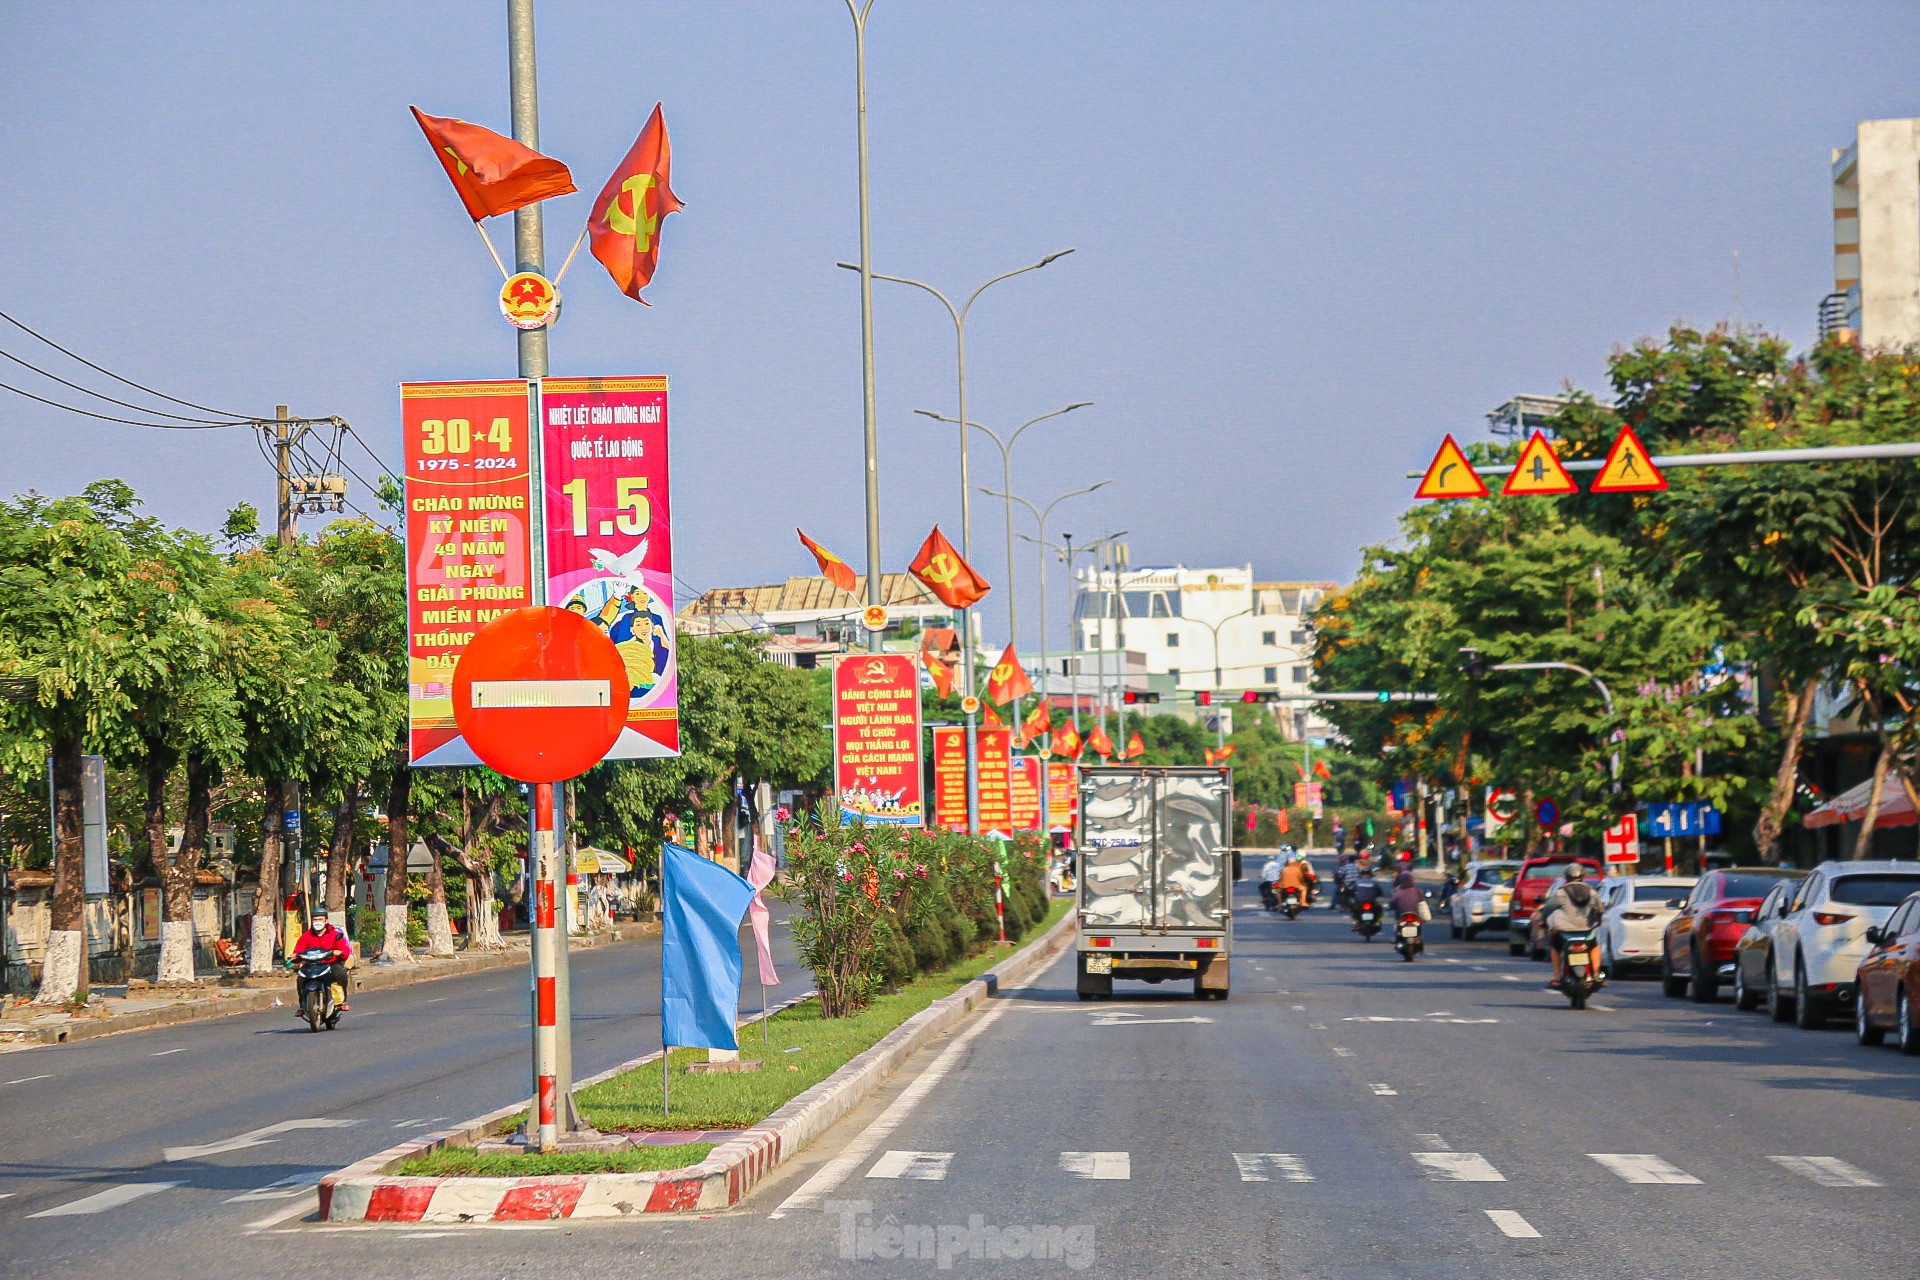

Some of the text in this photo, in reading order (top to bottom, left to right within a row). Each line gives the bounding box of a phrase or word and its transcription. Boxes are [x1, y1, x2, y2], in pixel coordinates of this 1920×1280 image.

[549, 402, 661, 429] NHIỆT LIỆT CHÀO MỪNG NGÀY
[421, 417, 512, 454] 30 4
[571, 435, 644, 461] QUỐC TẾ LAO ĐỘNG
[417, 459, 459, 471] 1975
[474, 458, 517, 470] 2024
[412, 494, 525, 512] CHÀO MỪNG
[562, 477, 652, 537] 1.5
[429, 516, 508, 535] KỶ NIỆM
[433, 539, 506, 556] 49 NĂM
[445, 561, 495, 578] NGÀY
[417, 583, 525, 601] GIẢI PHÓNG
[422, 606, 472, 624] MIỀN
[867, 688, 892, 701] CỘNG
[893, 687, 912, 699] SẢN
[856, 702, 898, 714] VIỆT NAM
[845, 741, 863, 752] MỌI
[895, 740, 910, 751] LỢI
[842, 752, 915, 764] CỦA CÁCH MẠNG
[856, 765, 875, 777] VIỆT
[876, 766, 897, 775] NAM
